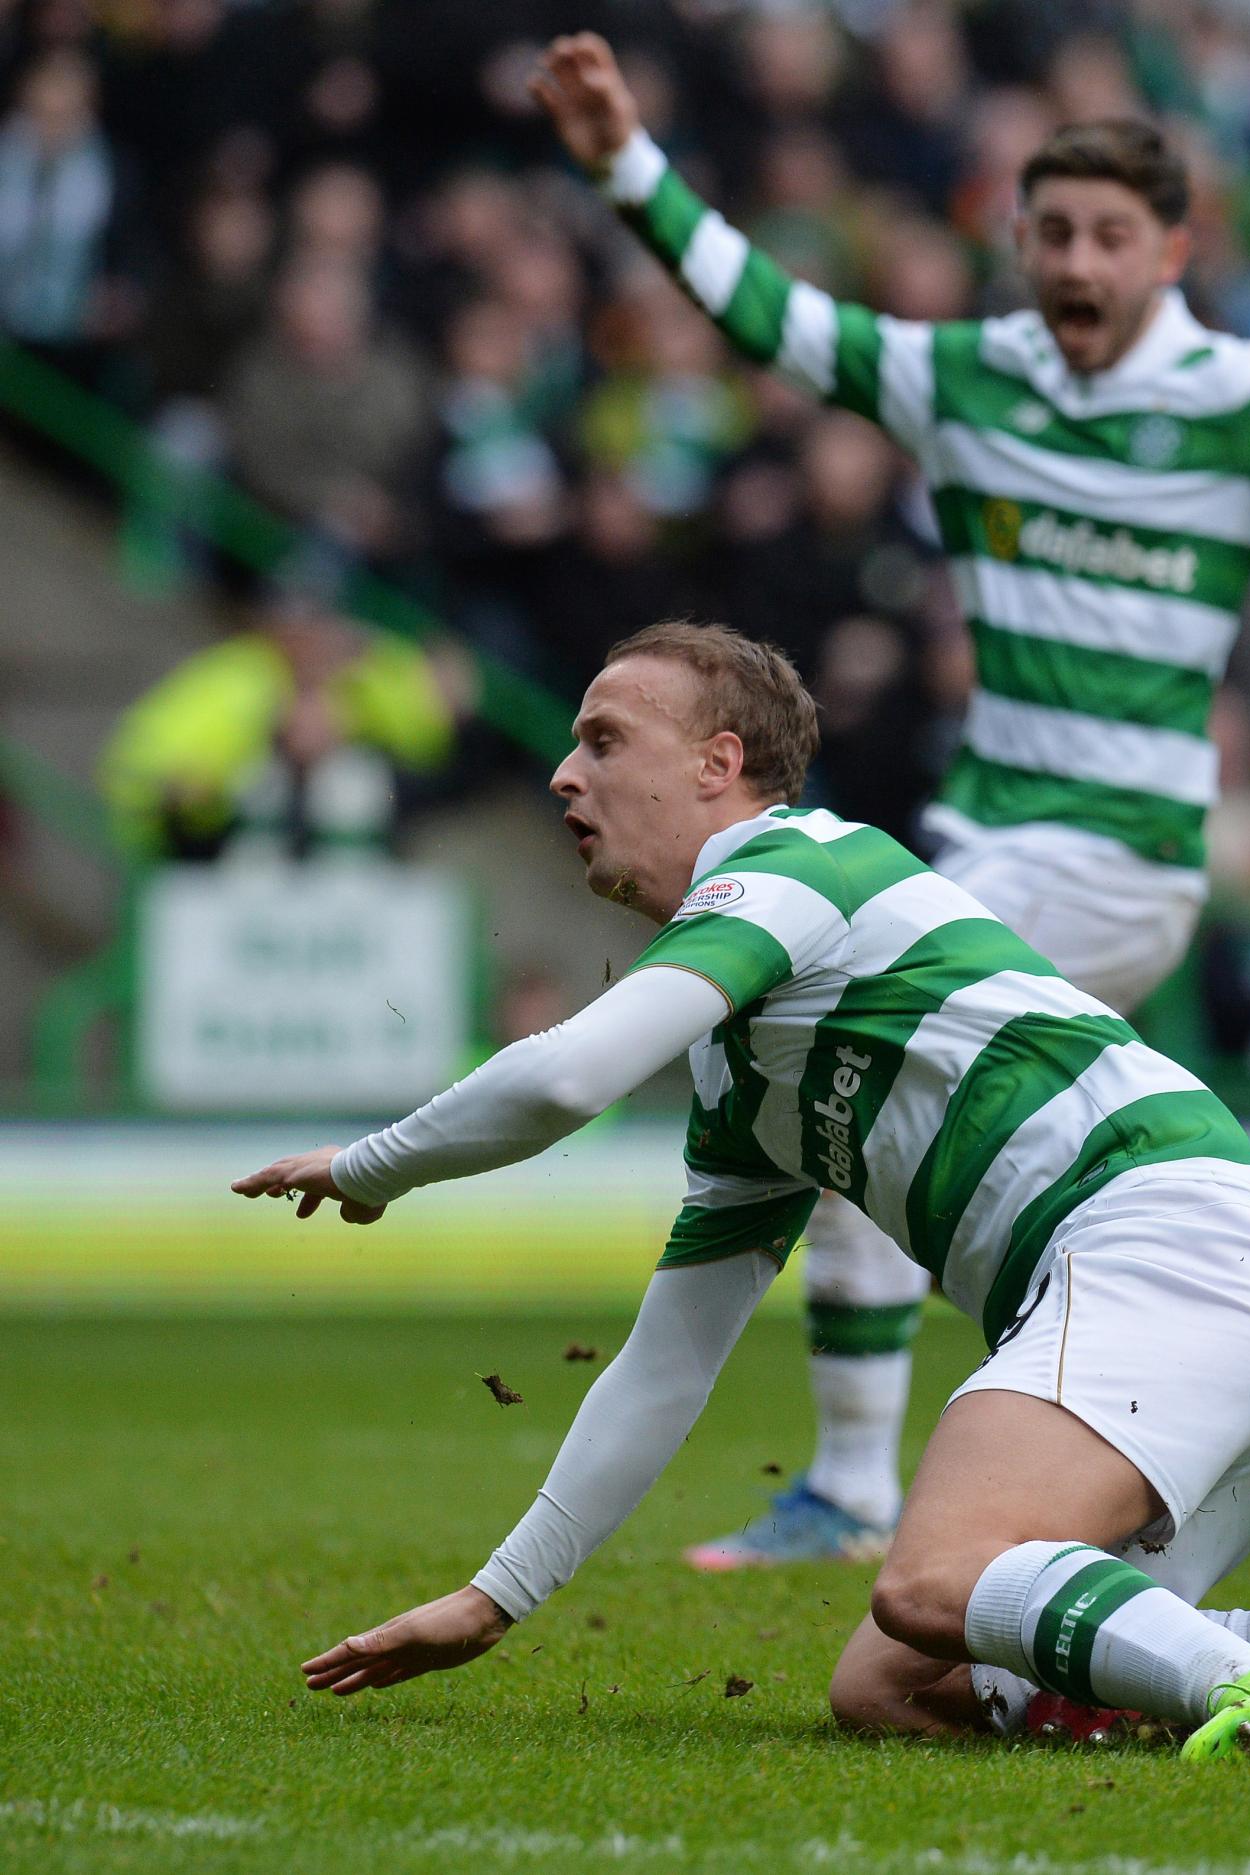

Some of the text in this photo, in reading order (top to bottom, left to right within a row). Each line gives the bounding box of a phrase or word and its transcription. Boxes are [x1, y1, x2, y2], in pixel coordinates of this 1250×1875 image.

[1019, 508, 1196, 594] dafabet
[813, 1045, 873, 1190] dafabet
[1055, 1592, 1098, 1675] CELTIC
